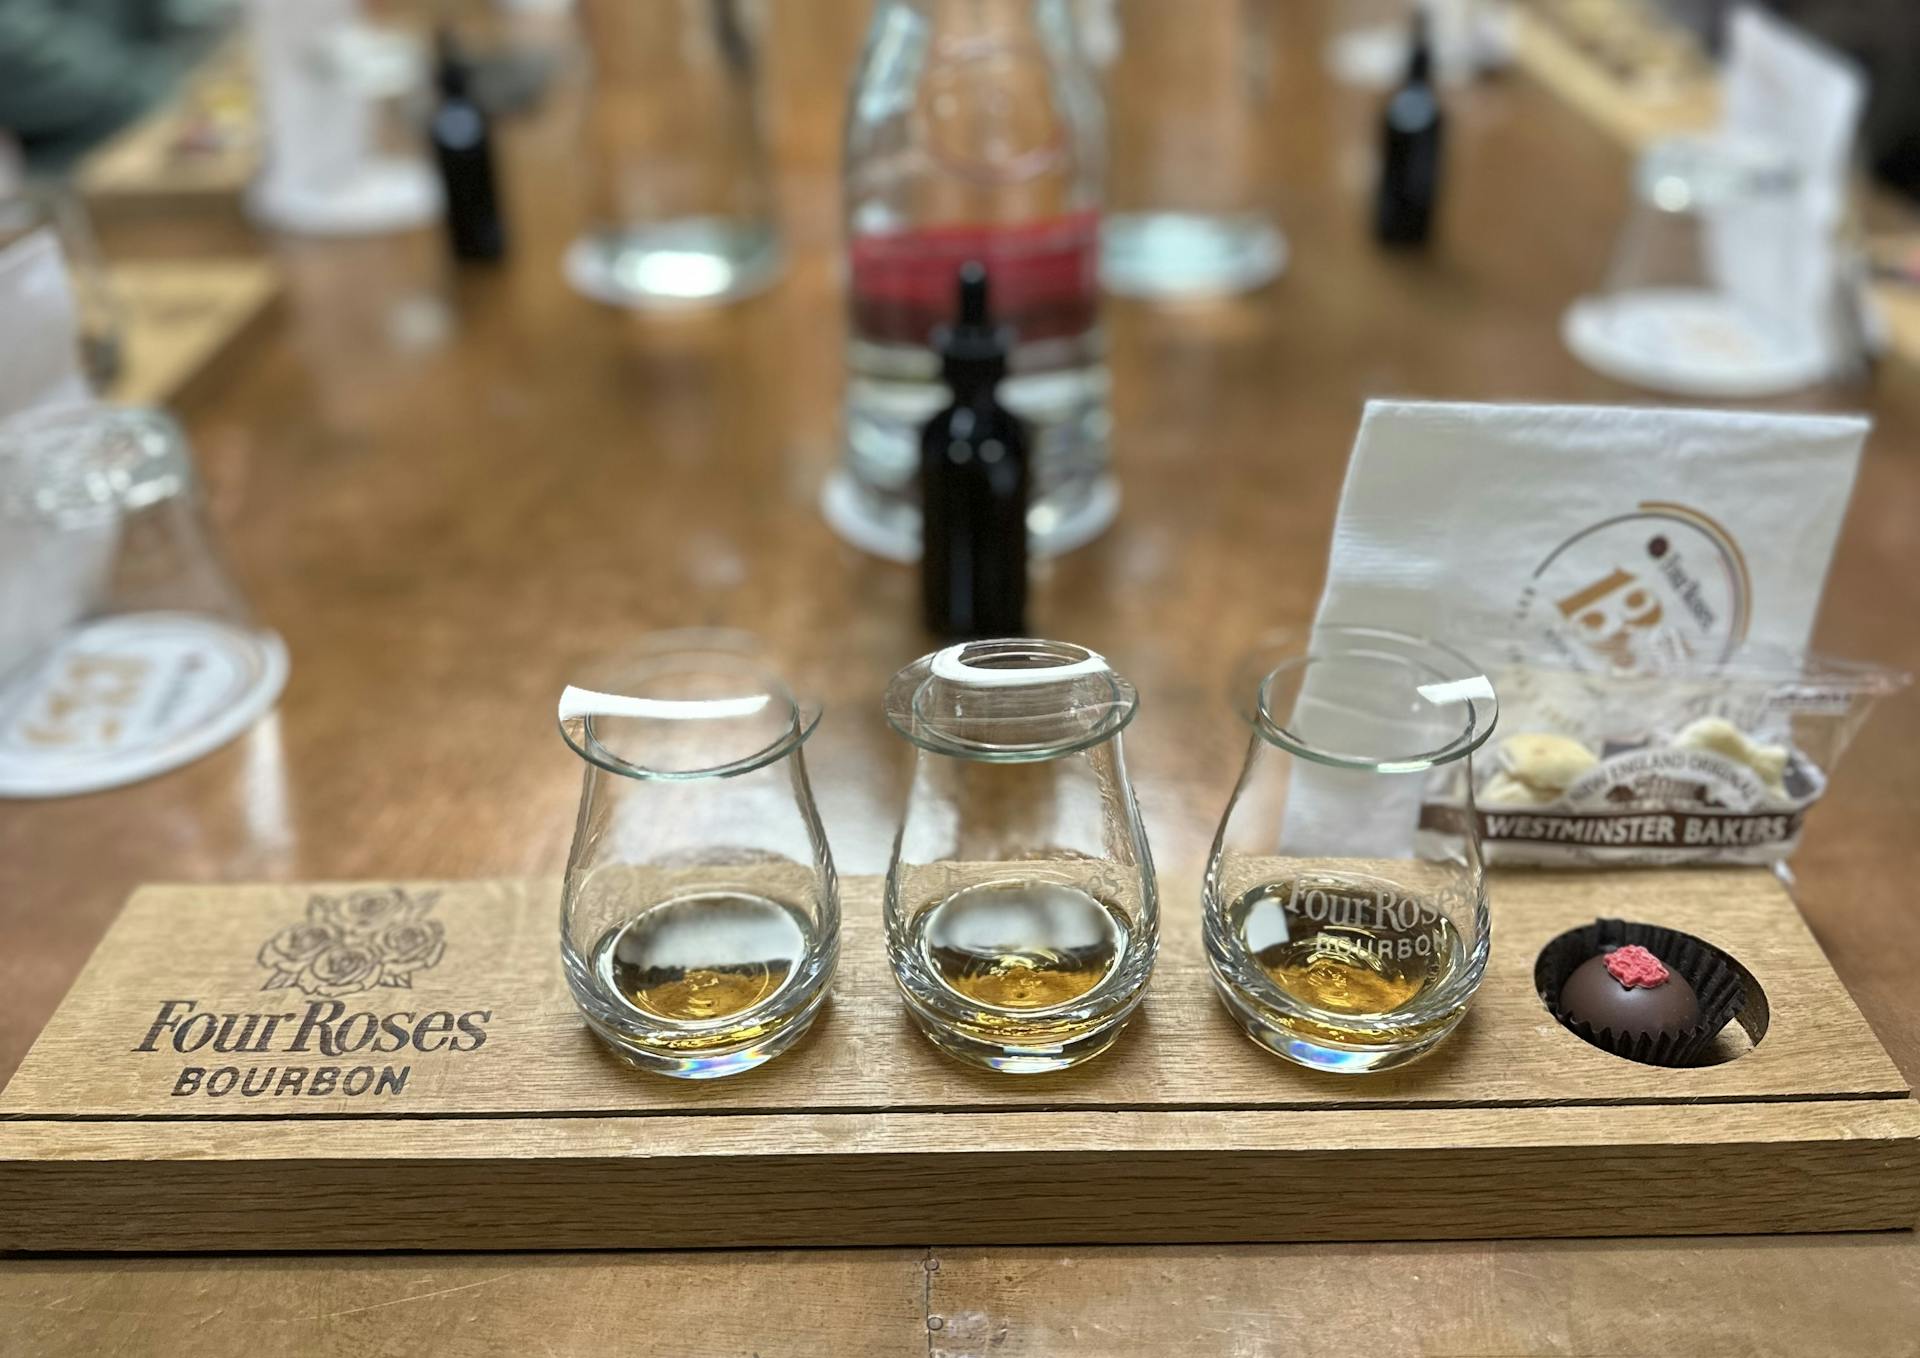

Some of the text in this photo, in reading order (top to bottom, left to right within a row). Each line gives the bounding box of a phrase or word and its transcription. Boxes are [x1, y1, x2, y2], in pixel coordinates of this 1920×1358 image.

[1485, 813, 1789, 844] WESTMINSTER BAKERS
[1285, 874, 1371, 927] Four
[1315, 931, 1447, 960] BOURBON
[131, 1000, 492, 1057] Four Roses
[171, 1066, 411, 1097] BOURBON
